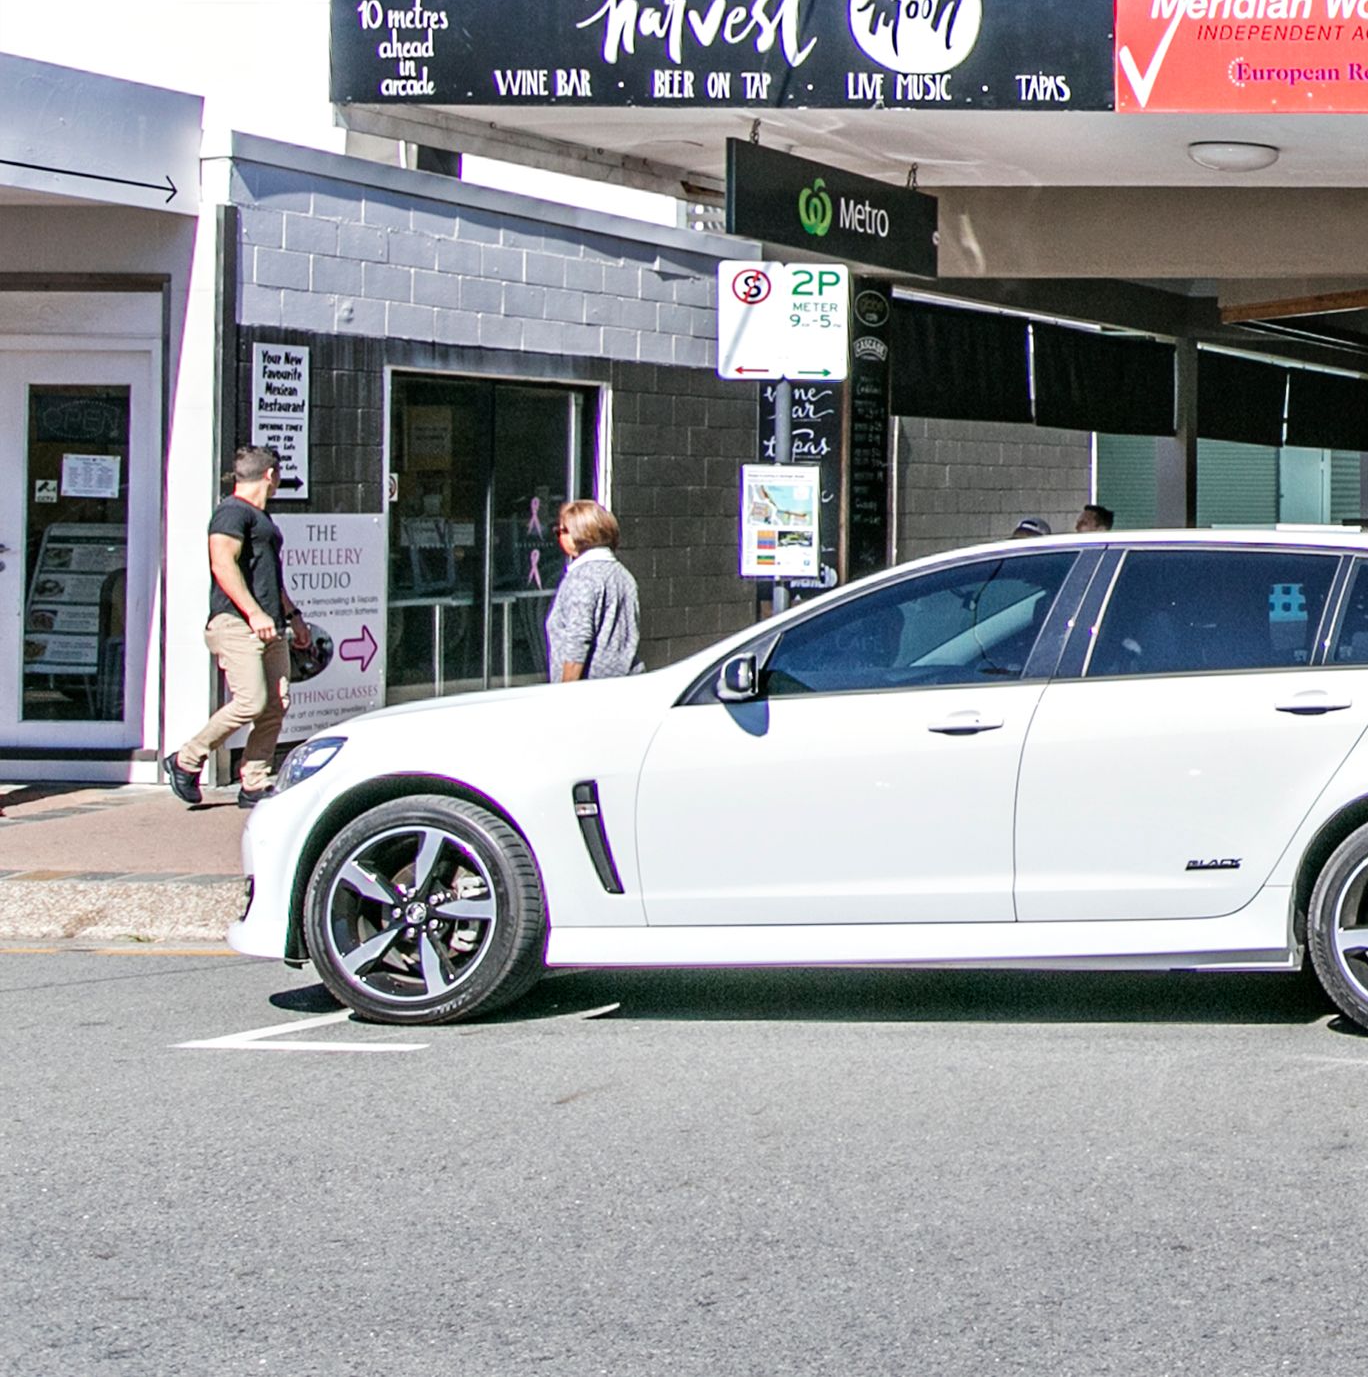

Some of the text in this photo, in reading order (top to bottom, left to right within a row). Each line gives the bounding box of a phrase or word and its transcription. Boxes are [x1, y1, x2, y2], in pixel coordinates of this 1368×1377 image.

[358, 0, 449, 30] 10 metres
[1196, 24, 1345, 41] INDEPENDENT
[378, 36, 435, 59] ahead
[398, 58, 417, 77] in
[1235, 62, 1340, 86] European
[380, 75, 437, 97] arcade
[494, 69, 1070, 102] WINE BAR BEER ON TAP LIVE MUSIC TAPAS
[839, 196, 889, 238] Metro
[791, 270, 841, 296] 2P
[792, 302, 838, 312] METER
[261, 350, 303, 366] Your New
[262, 366, 303, 382] Favourite
[264, 381, 298, 397] Mexican
[258, 397, 306, 414] Restaurant
[306, 524, 338, 541] THE
[291, 571, 351, 591] STUDIO
[337, 684, 378, 699] CLASSES
